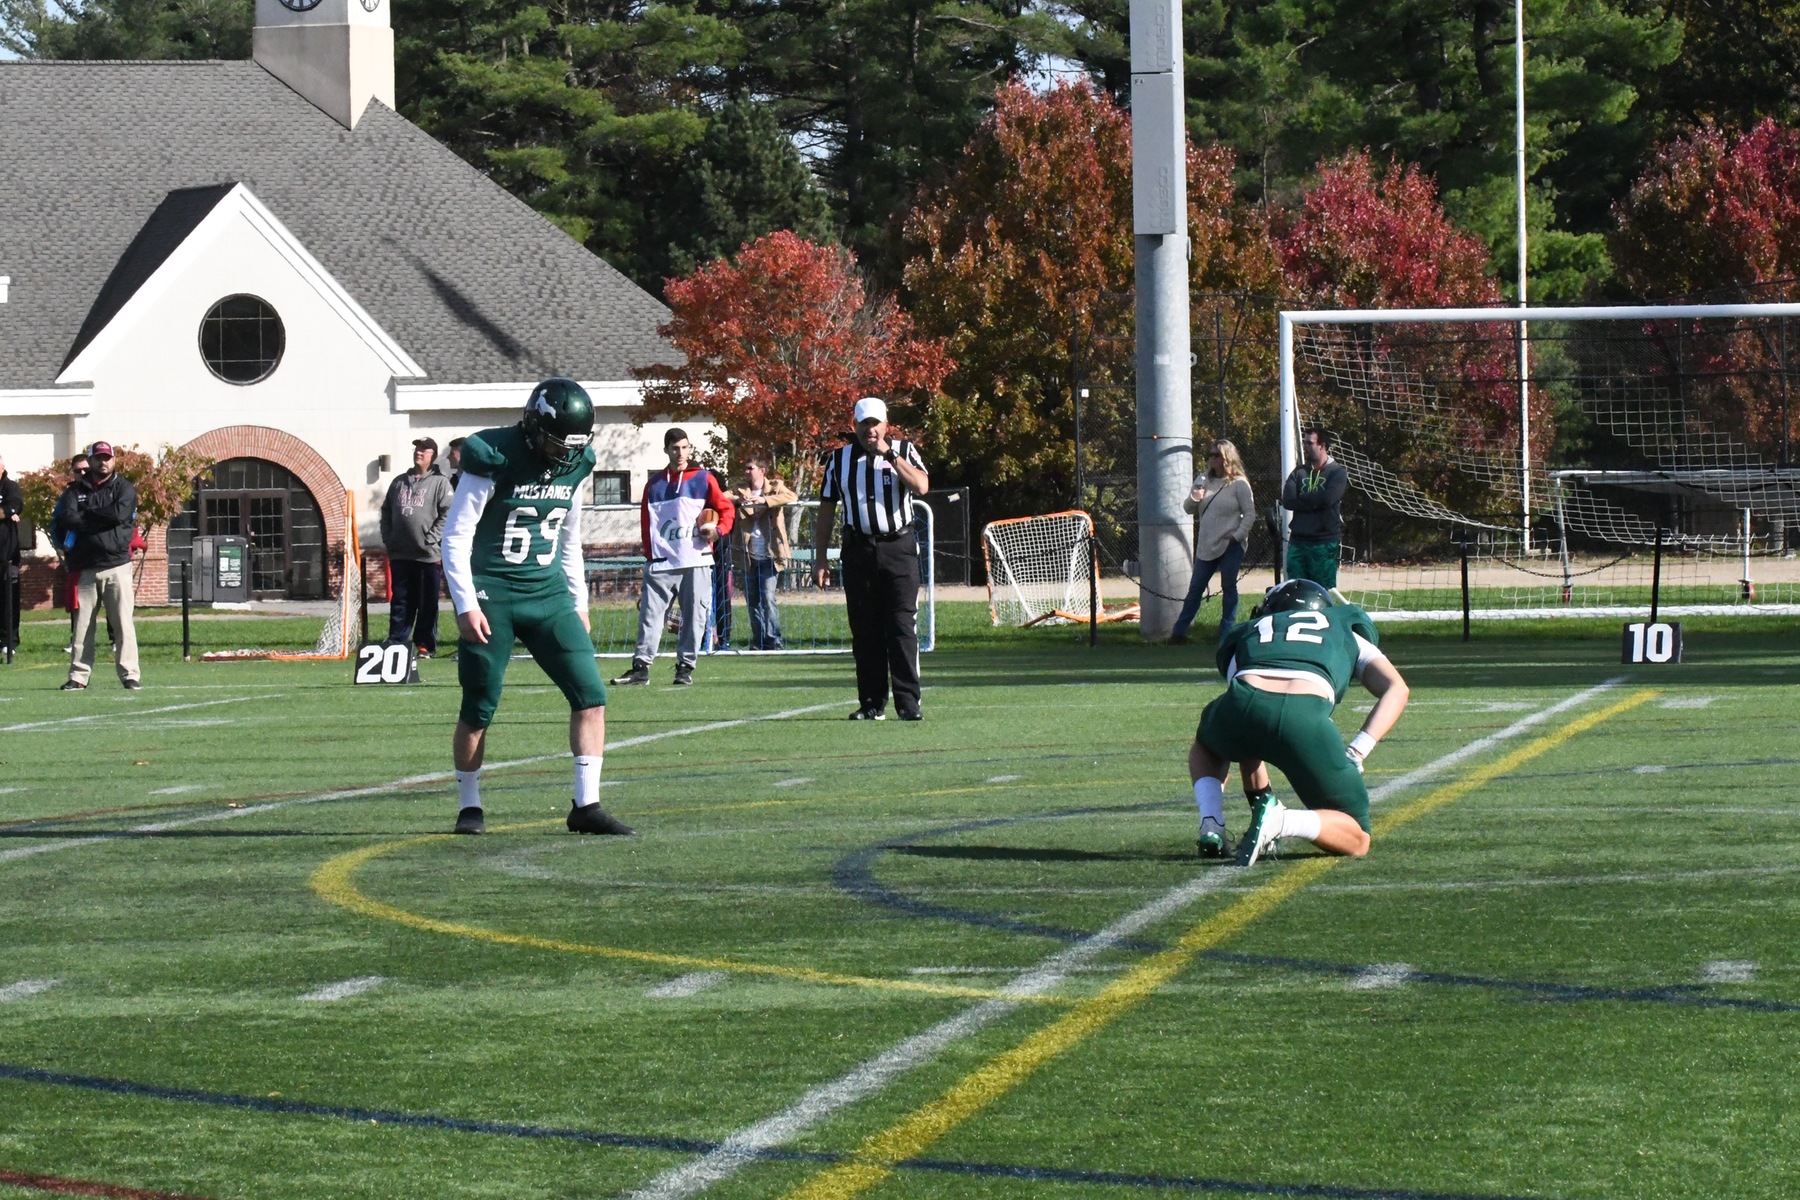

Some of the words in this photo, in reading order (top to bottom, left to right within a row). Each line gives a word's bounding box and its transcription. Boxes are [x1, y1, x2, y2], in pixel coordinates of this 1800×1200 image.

[512, 484, 573, 500] MUSTANGS
[883, 475, 891, 485] R
[502, 506, 569, 566] 69
[1254, 610, 1330, 644] 12
[1629, 623, 1673, 663] 10
[356, 644, 409, 683] 20
